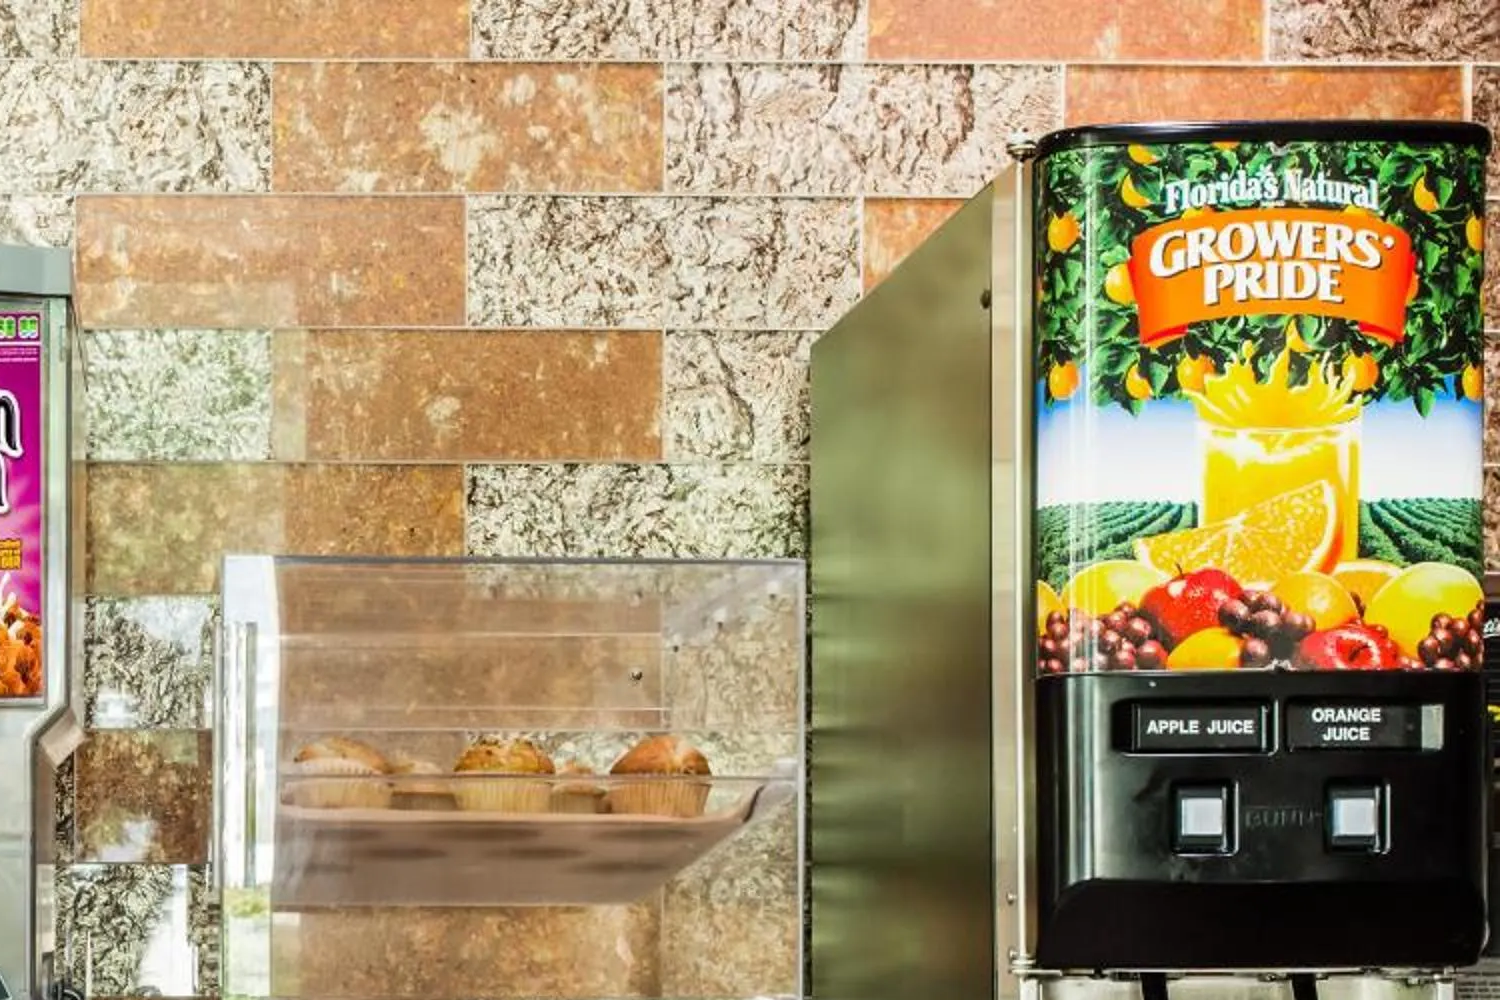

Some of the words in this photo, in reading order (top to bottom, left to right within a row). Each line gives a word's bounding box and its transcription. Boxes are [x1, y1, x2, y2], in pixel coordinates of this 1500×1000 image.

[1164, 169, 1279, 214] Florida's
[1283, 169, 1379, 210] Natural
[1202, 261, 1345, 306] PRIDE
[1311, 707, 1381, 723] ORANGE
[1146, 719, 1200, 735] APPLE
[1206, 719, 1255, 735] JUICE
[1322, 727, 1371, 742] JUICE
